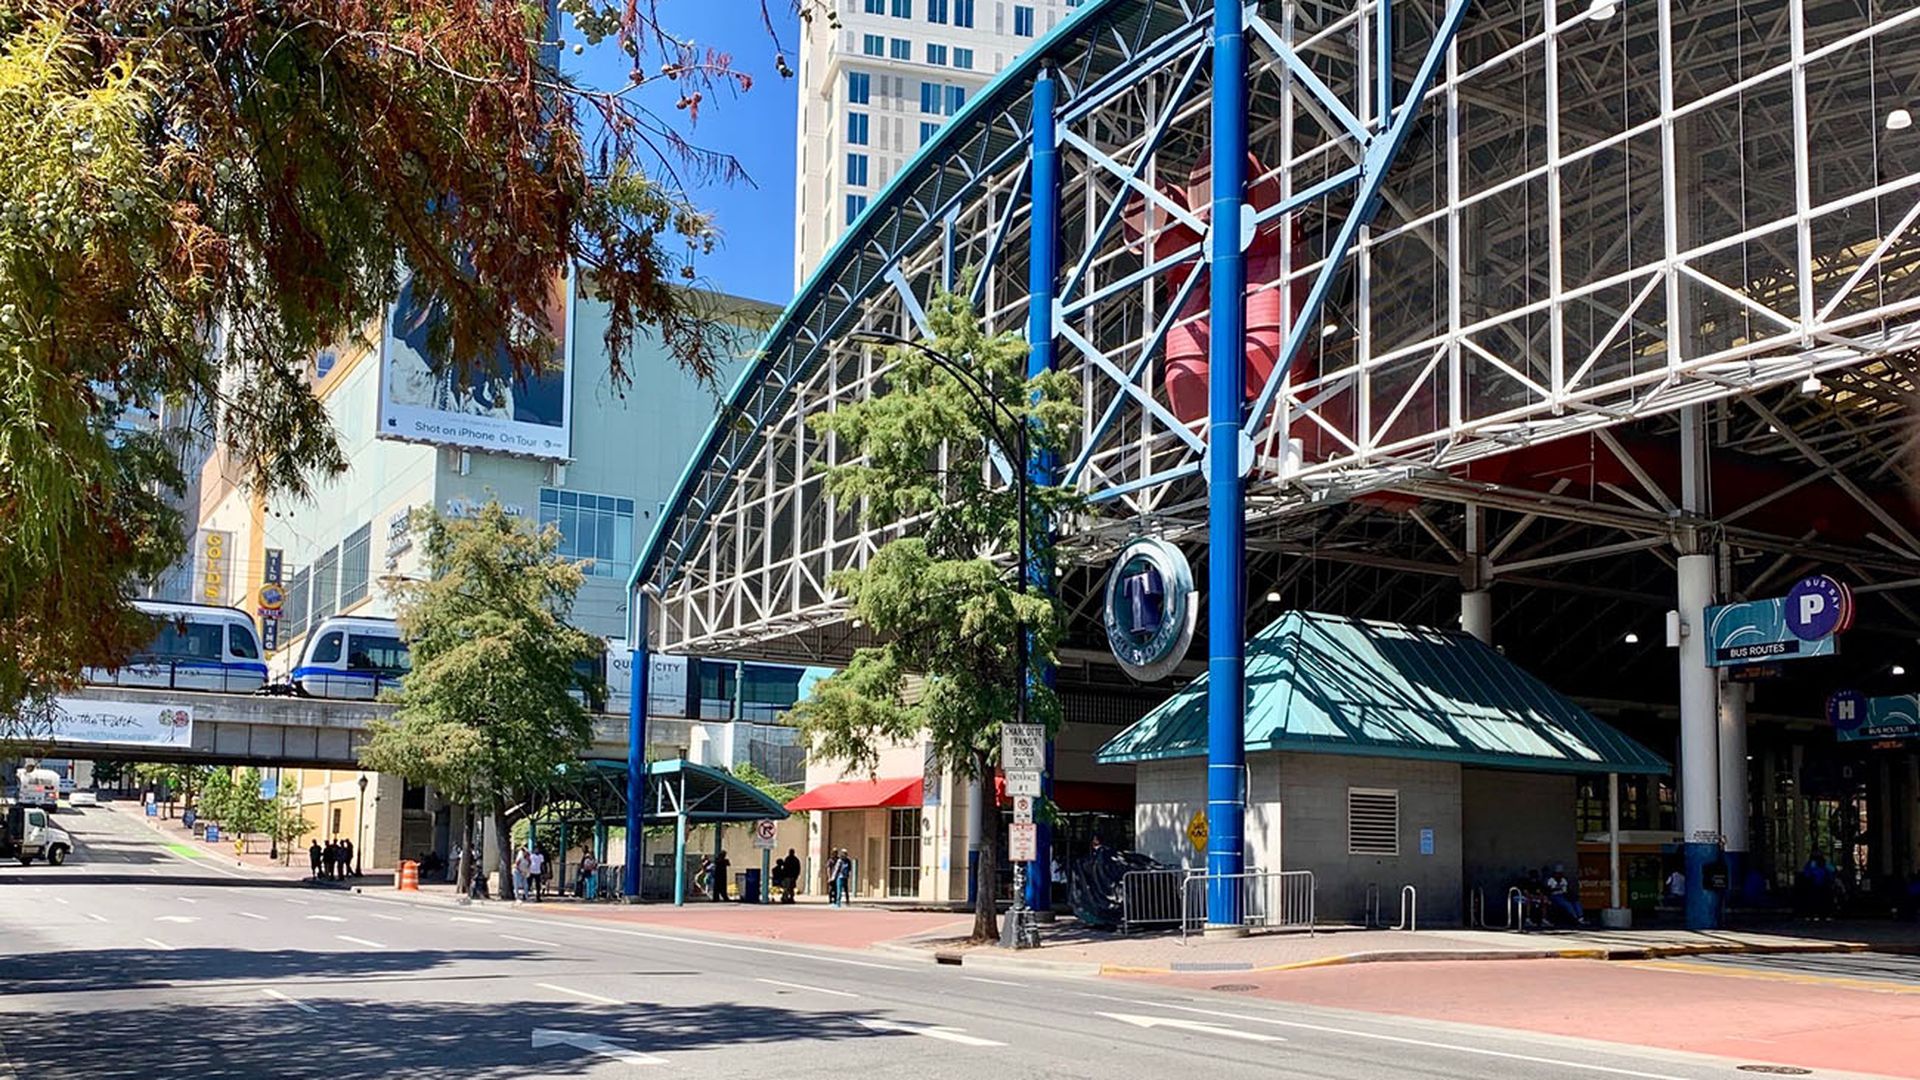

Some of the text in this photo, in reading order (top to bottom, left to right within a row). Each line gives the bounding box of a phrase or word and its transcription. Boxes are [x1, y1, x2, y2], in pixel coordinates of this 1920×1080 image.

[414, 420, 440, 434] Shot
[442, 427, 456, 436] on
[458, 427, 495, 442] iPhone
[501, 432, 515, 444] On
[517, 434, 537, 447] Tour
[269, 550, 279, 581] WILD
[1805, 579, 1840, 610] BUS BAY
[1799, 593, 1825, 625] P
[265, 619, 276, 650] WING
[1730, 643, 1785, 658] BUS ROUTES
[655, 662, 680, 673] CITY
[1838, 700, 1855, 720] H
[1004, 727, 1043, 737] CHARLOTTE
[1009, 738, 1039, 746] TRANSIT
[1012, 747, 1035, 757] BUSES
[1014, 758, 1032, 767] ONLY
